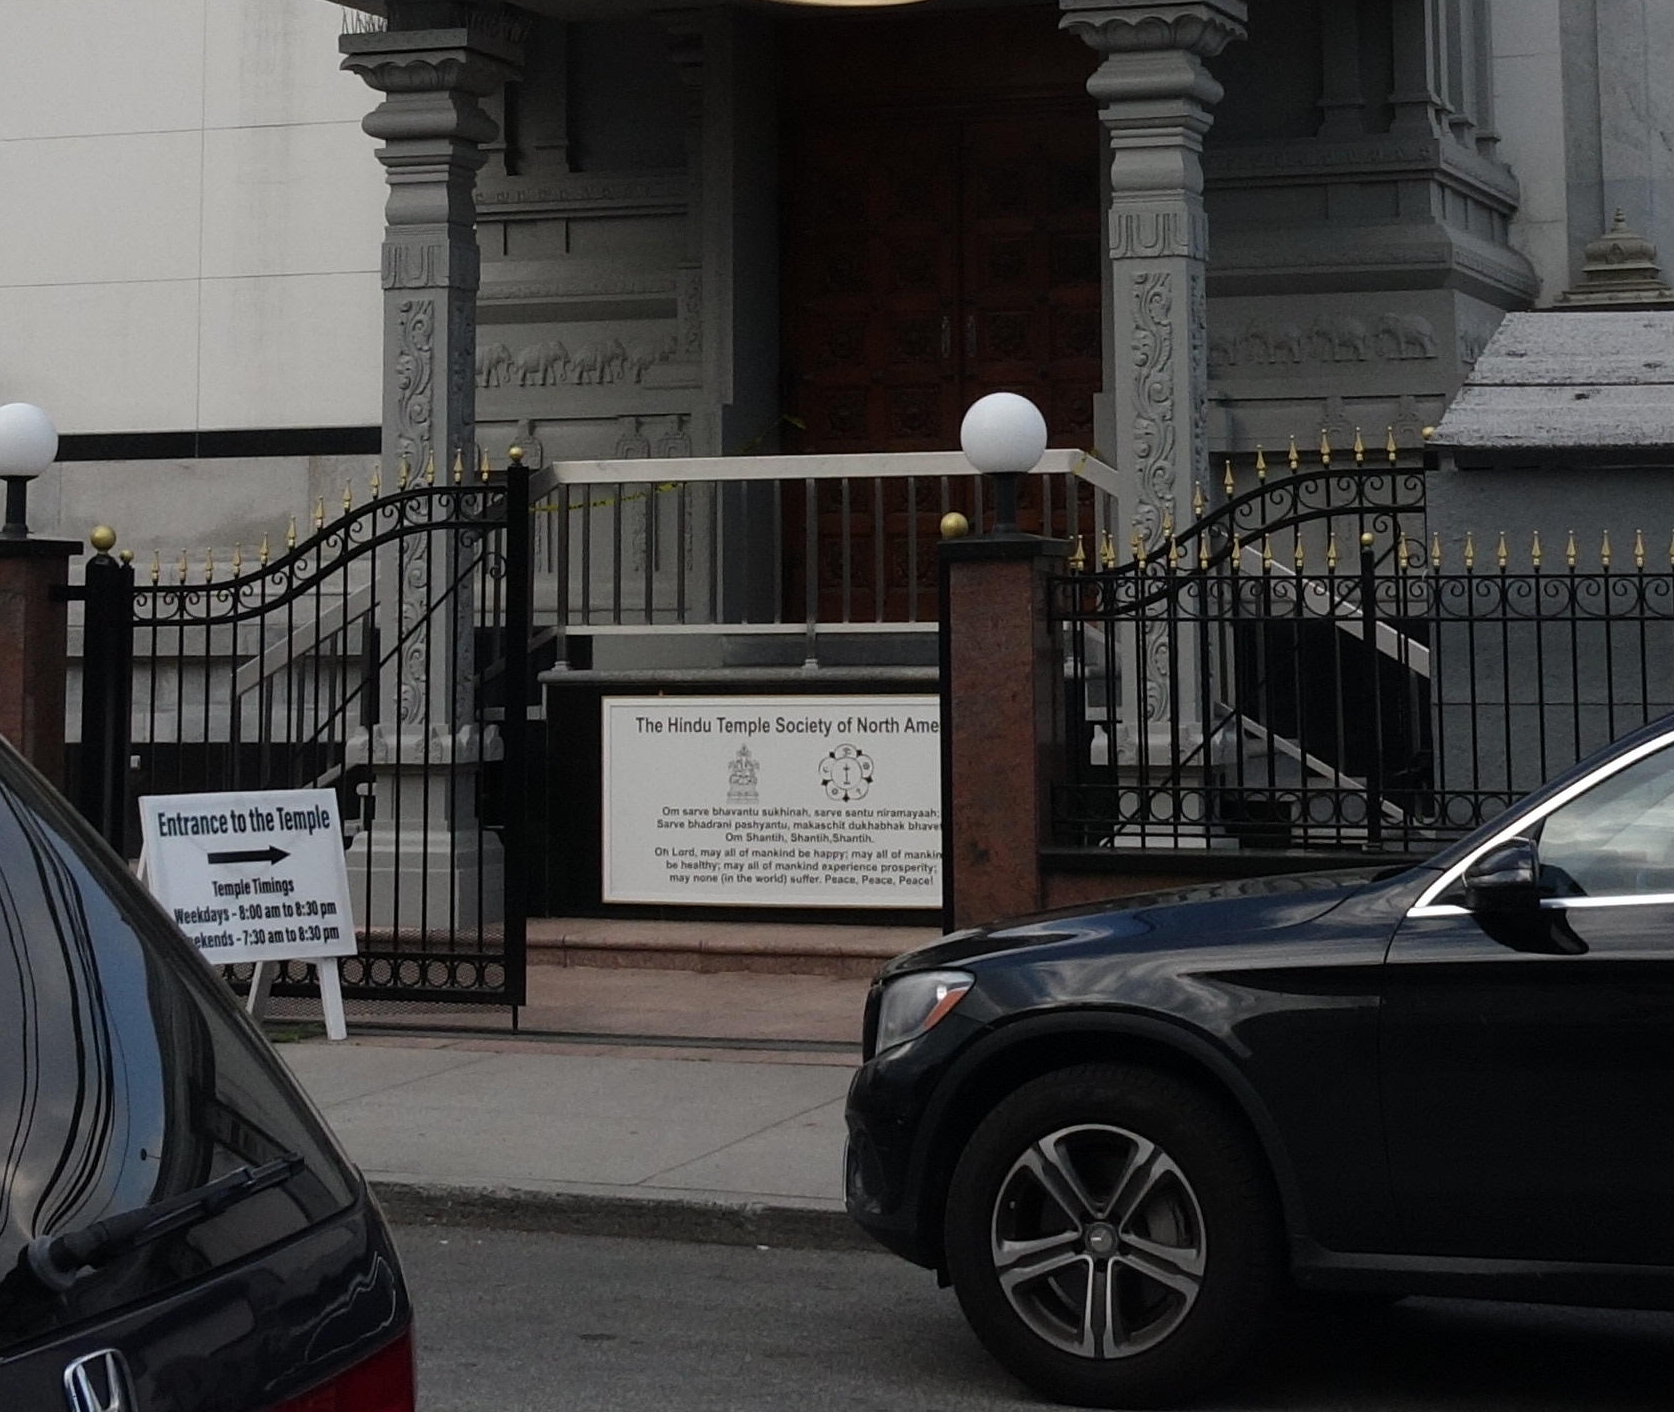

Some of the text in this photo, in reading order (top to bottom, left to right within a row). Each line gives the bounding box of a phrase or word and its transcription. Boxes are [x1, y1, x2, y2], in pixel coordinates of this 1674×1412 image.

[635, 716, 664, 734] The
[668, 716, 711, 734] Hindu
[715, 716, 770, 738] Temple
[775, 716, 833, 738] Society
[837, 716, 855, 734] of
[857, 716, 900, 734] North
[662, 806, 679, 817] Om
[682, 808, 709, 817] sarve
[712, 807, 759, 817] bhavantu
[814, 808, 842, 818] sarve
[844, 808, 874, 818] santu
[158, 804, 330, 837] Entrance to the Temple
[657, 819, 685, 829] Sarve
[688, 819, 732, 829] bhadrani
[735, 820, 790, 832] pashyantu,
[793, 820, 844, 831] makaschit
[848, 820, 905, 832] dukhabhak
[725, 832, 743, 842] Om
[654, 847, 669, 857] Oh
[701, 849, 721, 859] may
[724, 848, 736, 857] all
[739, 848, 749, 857] of
[752, 848, 795, 858] mankind
[798, 848, 811, 858] be
[851, 851, 873, 862] may
[875, 849, 888, 859] all
[891, 849, 901, 859] of
[666, 860, 678, 870] be
[723, 863, 745, 874] may
[748, 861, 759, 870] all
[762, 861, 772, 870] of
[775, 861, 819, 871] mankind
[822, 862, 877, 873] experience
[670, 874, 690, 884] may
[693, 874, 718, 884] none
[721, 873, 734, 885] (in
[737, 873, 752, 884] the
[755, 873, 787, 886] world)
[212, 878, 295, 899] Temple Timings
[174, 906, 229, 925] Weekdays
[239, 904, 262, 920] 8:00
[265, 905, 281, 918] am
[283, 903, 293, 917] to
[295, 901, 317, 916] 8:30
[320, 902, 337, 919] pm
[243, 929, 266, 946] 7:30
[268, 931, 284, 944] am
[285, 928, 297, 942] to
[298, 925, 320, 941] 8:30
[323, 926, 340, 943] pm
